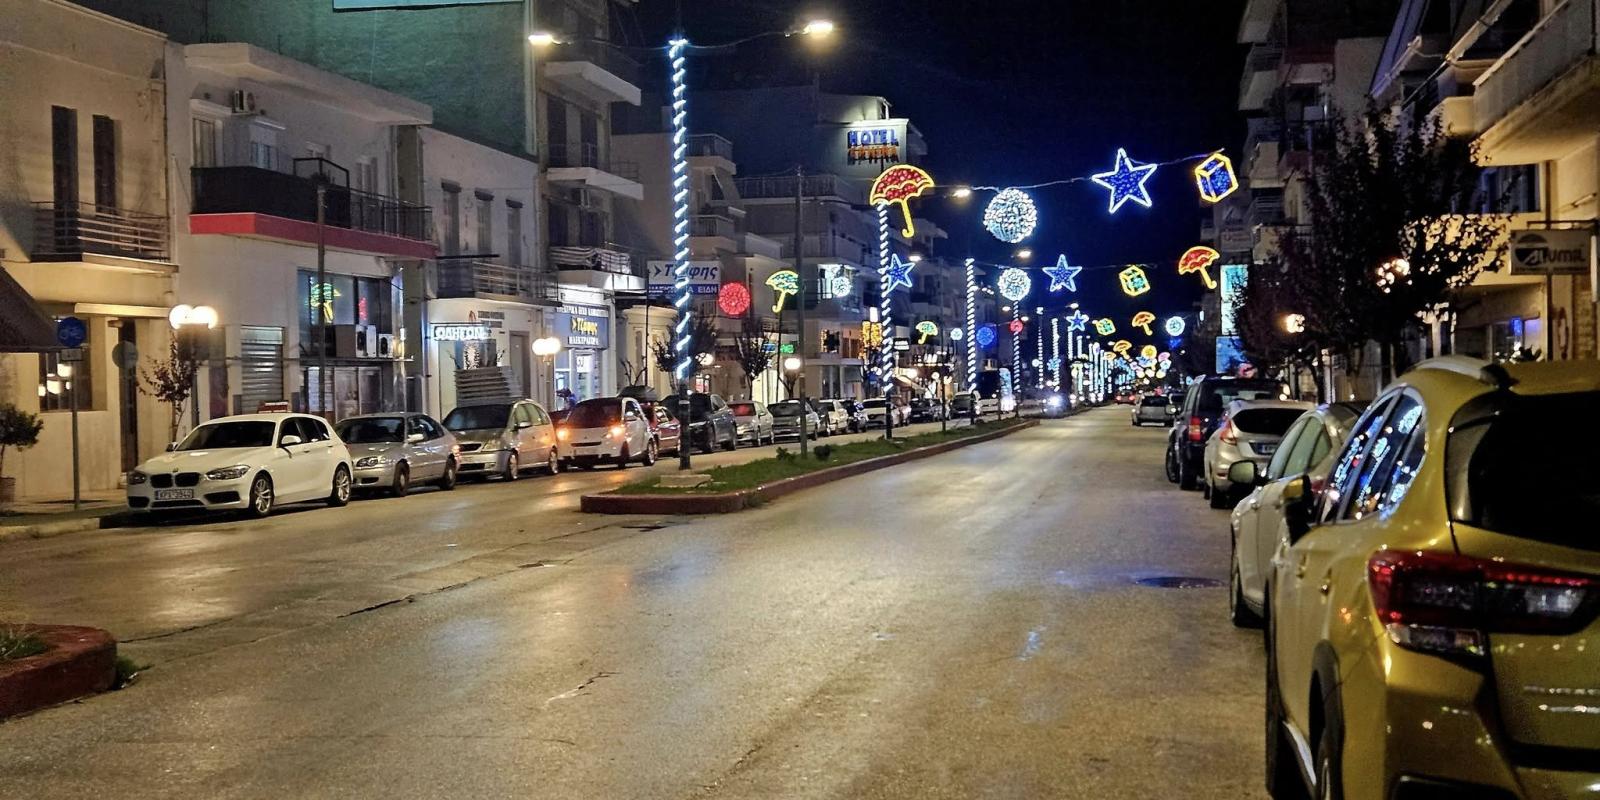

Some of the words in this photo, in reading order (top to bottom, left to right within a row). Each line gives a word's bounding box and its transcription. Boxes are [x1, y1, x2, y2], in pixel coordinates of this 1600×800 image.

[848, 129, 898, 145] HOTEL
[664, 263, 718, 280] Τζφης
[697, 285, 717, 294] ΕΙΔΗ
